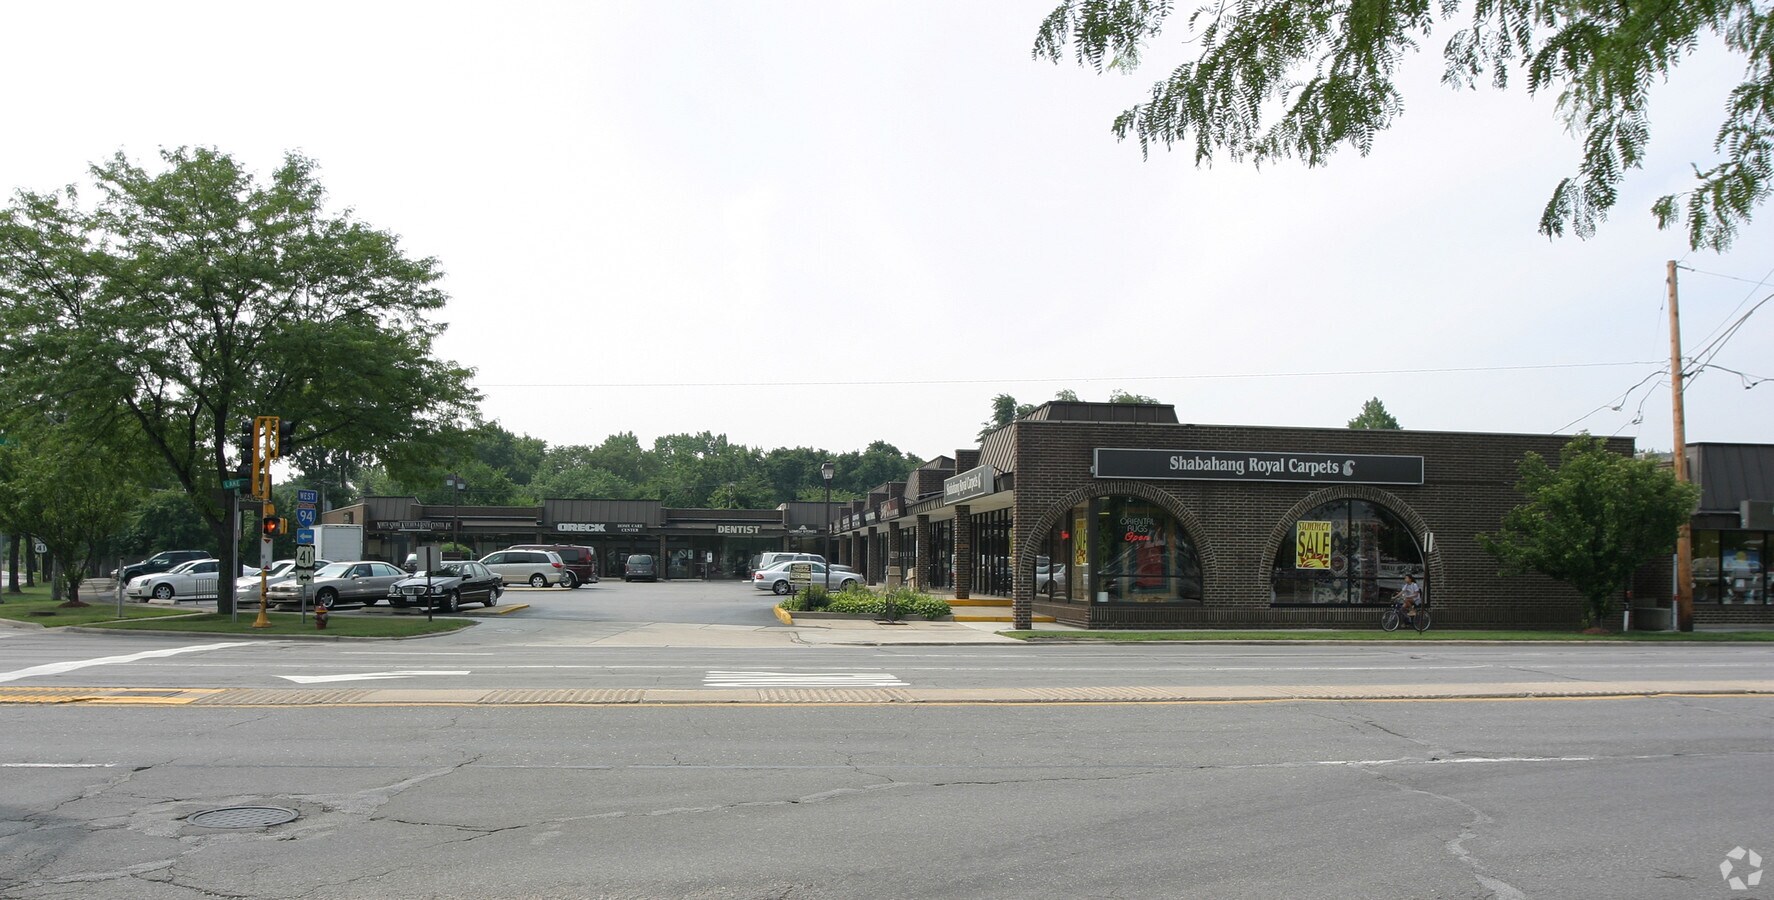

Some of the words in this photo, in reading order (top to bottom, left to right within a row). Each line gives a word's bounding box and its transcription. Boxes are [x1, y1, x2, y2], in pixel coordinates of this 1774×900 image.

[1169, 456, 1245, 475] Shabahang
[1249, 458, 1285, 475] Royal
[1288, 458, 1339, 477] Carpets
[300, 492, 315, 500] WEST
[300, 510, 313, 522] 94
[557, 523, 606, 532] ORECK
[717, 525, 760, 534] DENTIST
[1127, 525, 1148, 533] RUGS
[1124, 532, 1151, 543] Open
[1298, 531, 1330, 558] SALE
[300, 551, 311, 564] 41
